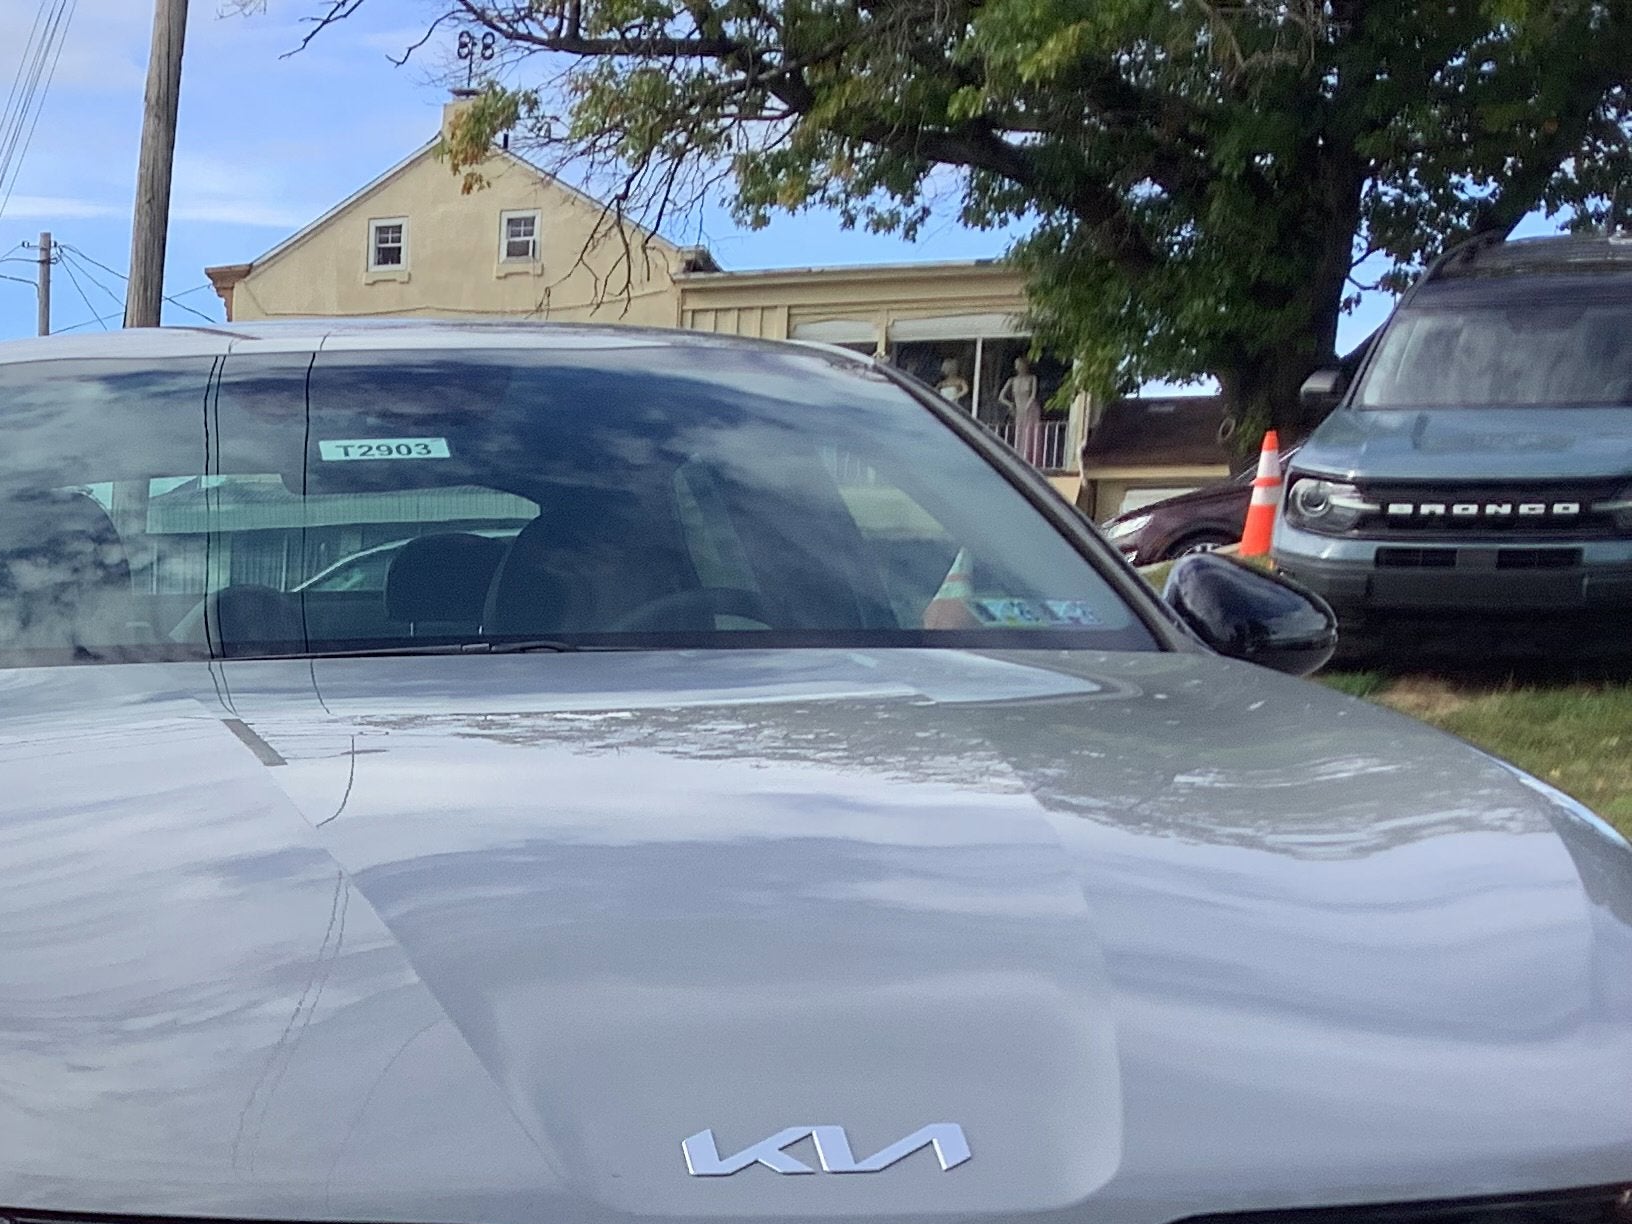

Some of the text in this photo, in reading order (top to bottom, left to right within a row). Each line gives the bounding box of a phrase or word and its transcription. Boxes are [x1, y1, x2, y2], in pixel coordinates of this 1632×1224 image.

[335, 443, 432, 458] T2903
[1387, 502, 1581, 515] BRONCO
[681, 1122, 972, 1177] KIA
